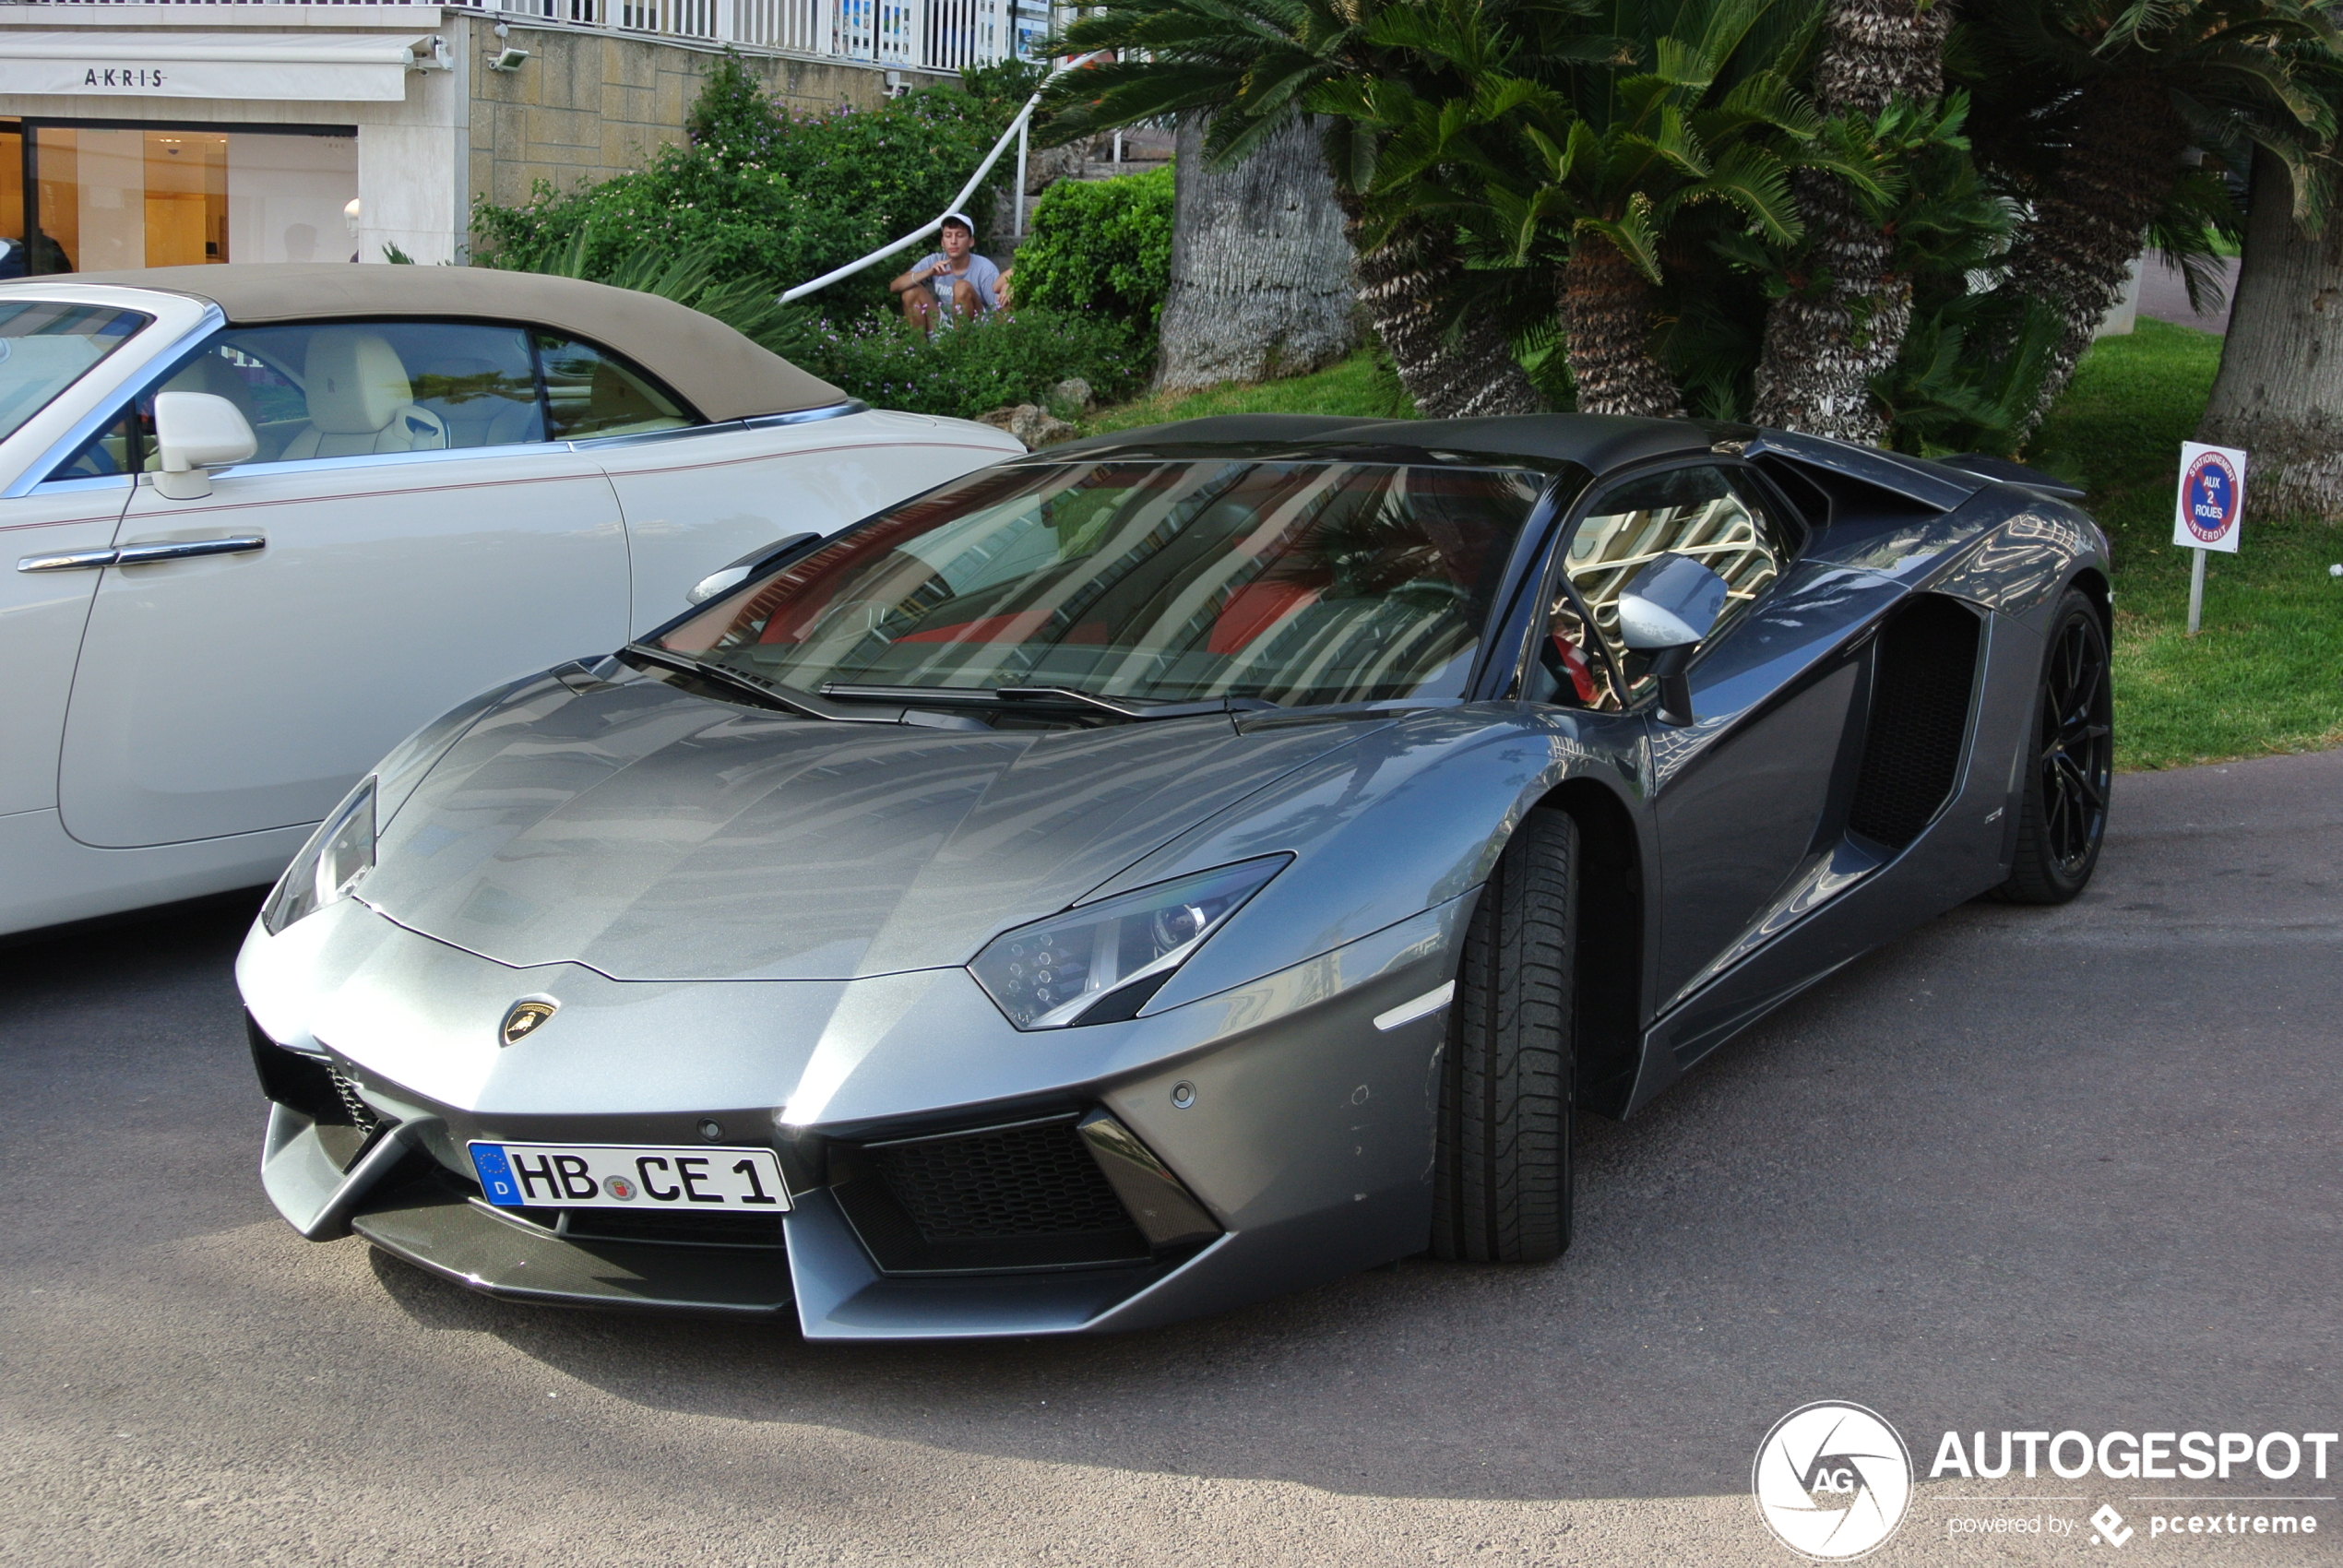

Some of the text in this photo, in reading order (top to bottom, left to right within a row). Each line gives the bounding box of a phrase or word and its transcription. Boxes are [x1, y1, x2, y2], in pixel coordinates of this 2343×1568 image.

[2189, 454, 2235, 481] STATIONNEMENT
[2203, 476, 2220, 489] AUX
[2206, 491, 2214, 504] 2
[2195, 505, 2222, 519] ROUES
[2189, 519, 2226, 540] INTERDIT
[511, 1153, 599, 1200] HB
[636, 1156, 725, 1204] CE
[732, 1159, 777, 1205] 1
[494, 1182, 509, 1195] D
